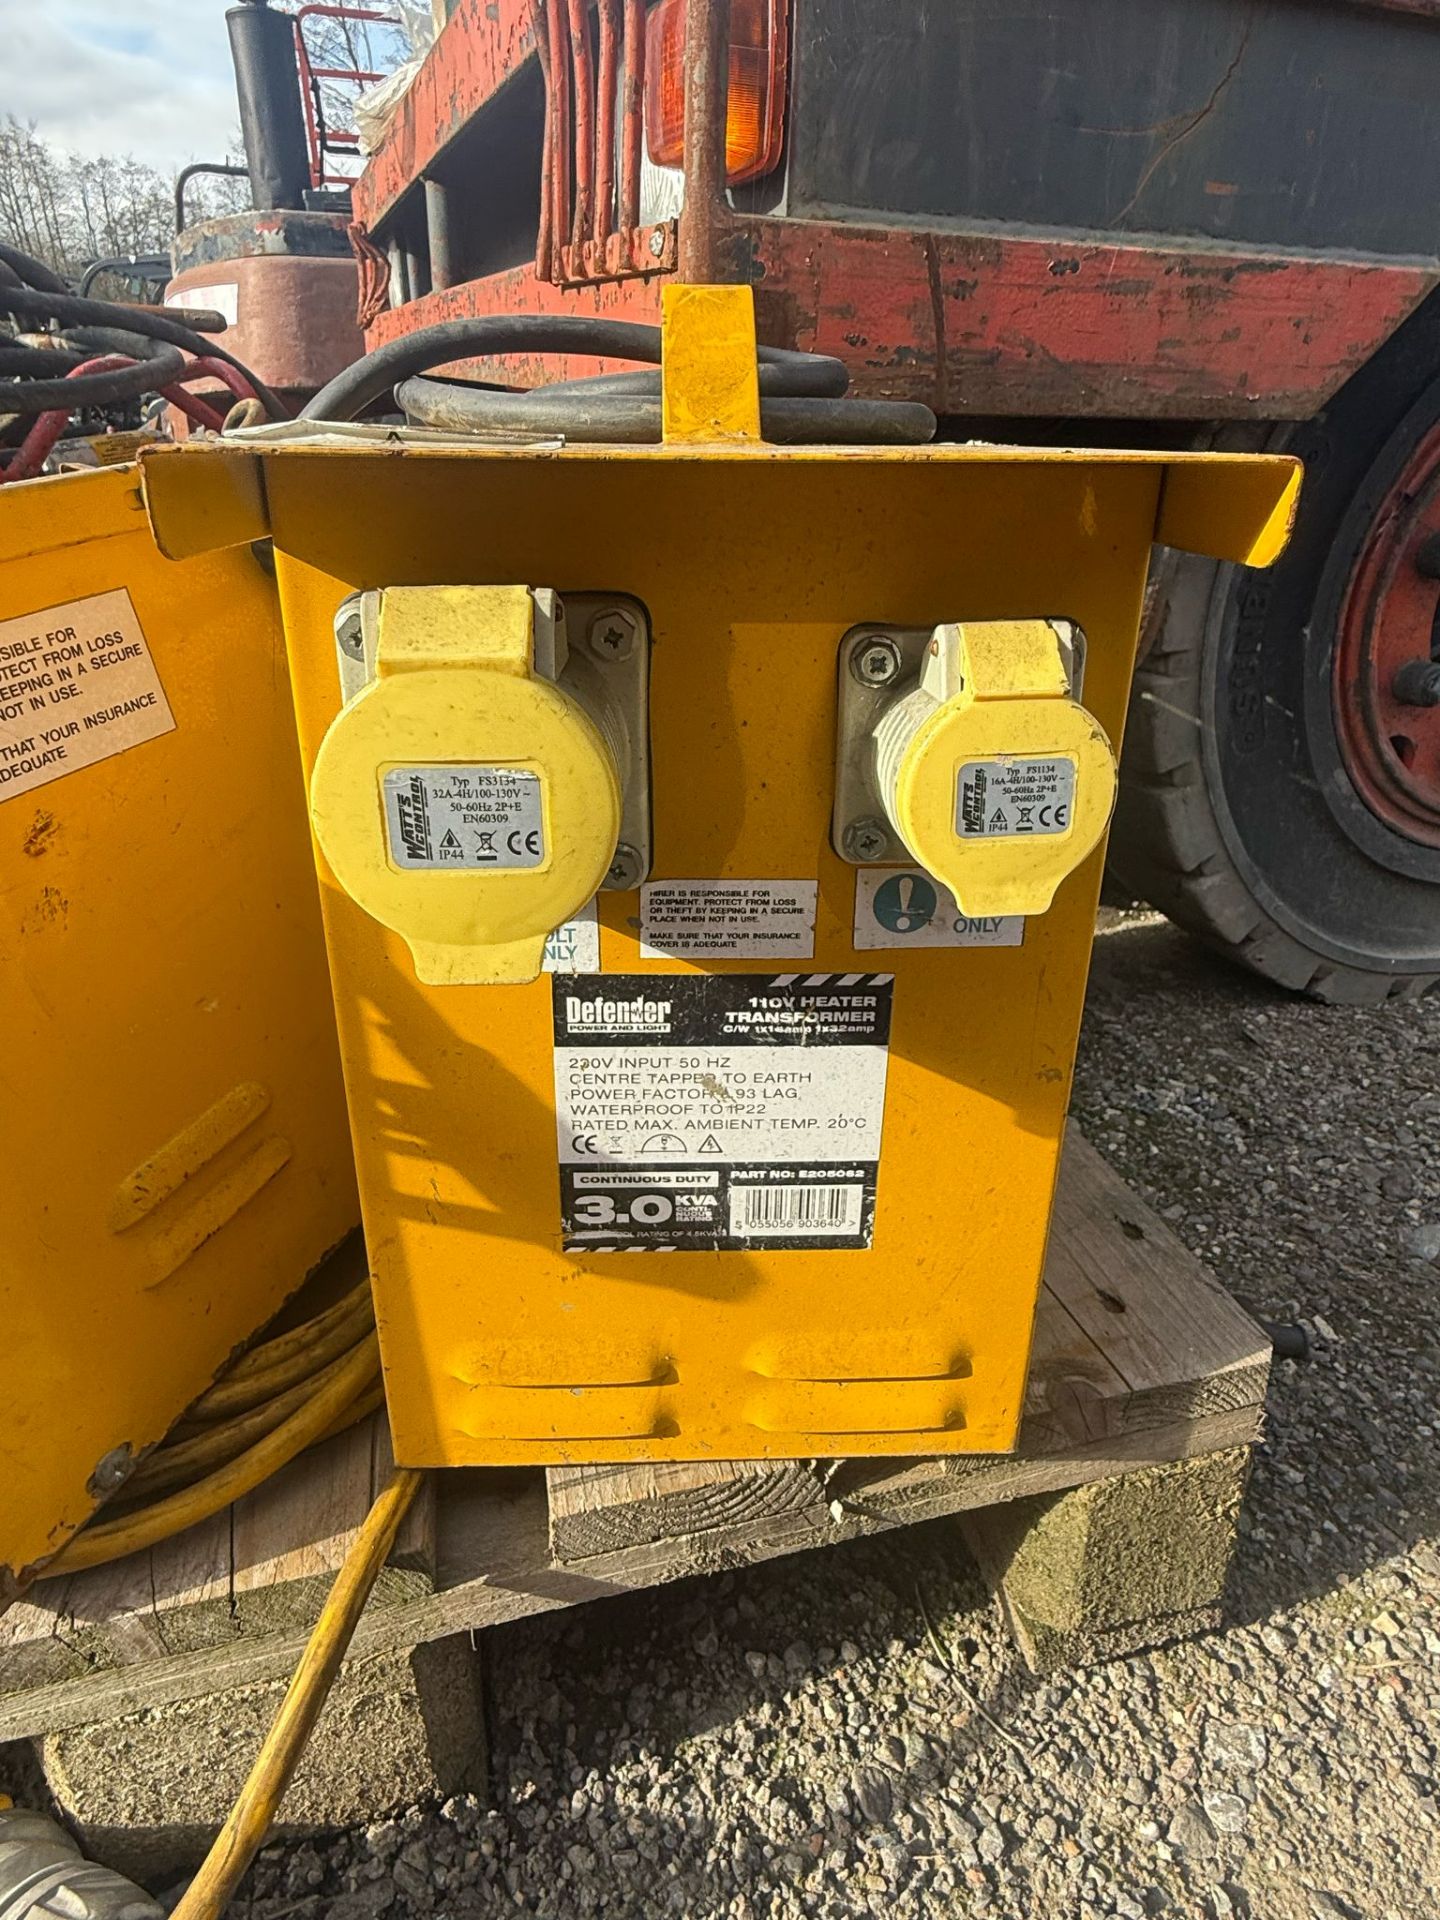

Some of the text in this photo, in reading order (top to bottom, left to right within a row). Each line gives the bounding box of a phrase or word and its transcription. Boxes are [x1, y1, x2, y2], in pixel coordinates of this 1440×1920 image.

[0, 627, 77, 662] SIBLE FOR
[0, 630, 124, 682] TECT FROM LOSS
[0, 643, 143, 702] EEPING IN A SECURE
[29, 695, 46, 711] IN
[48, 683, 83, 704] USE.
[0, 692, 157, 761] THAT YOUR INSURANCE
[0, 745, 68, 783] DEQUATE
[1006, 765, 1055, 776] Typ FS1134
[451, 776, 517, 787] Typ FS3134
[432, 788, 521, 799] 32A-4H/100-130V
[1036, 785, 1057, 793] 2P+E
[1011, 794, 1046, 803] EN60309
[450, 802, 522, 812] 50-60Hz 2P+E
[463, 813, 509, 824] EN60309
[1039, 804, 1067, 827] CE
[989, 823, 1008, 832] IP44
[507, 830, 540, 856] CE
[439, 849, 465, 860] IP44
[704, 898, 742, 906] PROTECT
[745, 898, 770, 906] FROM
[773, 898, 796, 906] LOSS
[771, 907, 805, 915] SECURE
[649, 915, 677, 923] PLACE
[680, 915, 705, 923] WHEN
[709, 915, 726, 923] NOT
[729, 915, 738, 923] IN
[953, 918, 1003, 933] ONLY
[650, 932, 801, 940] MAKE SURE THAT YOUR INSURANCE
[544, 945, 577, 959] NLY
[749, 996, 877, 1008] 110V HEATER
[566, 995, 672, 1023] Defender
[725, 1011, 875, 1023] TRANSFORMER
[723, 1025, 750, 1033] C/W
[619, 1057, 673, 1069] INPUT
[679, 1057, 700, 1069] 50
[707, 1057, 731, 1068] HZ
[570, 1073, 641, 1085] CENTRE
[723, 1072, 747, 1084] TO
[754, 1072, 812, 1084] EARTH
[571, 1089, 635, 1100] POWER
[571, 1104, 693, 1115] WATERPROOF
[699, 1104, 723, 1115] TO
[571, 1117, 867, 1131] RATED MAX. AMBIENT TEMP. 20°C
[572, 1135, 598, 1154] CE
[580, 1176, 672, 1184] CONTINUOUS
[730, 1170, 767, 1179] PART
[770, 1170, 795, 1178] NO:
[675, 1195, 718, 1206] KVA
[574, 1194, 673, 1225] 3.0
[734, 1221, 743, 1230] 5
[749, 1219, 794, 1229] 055056
[798, 1219, 842, 1229] 903640
